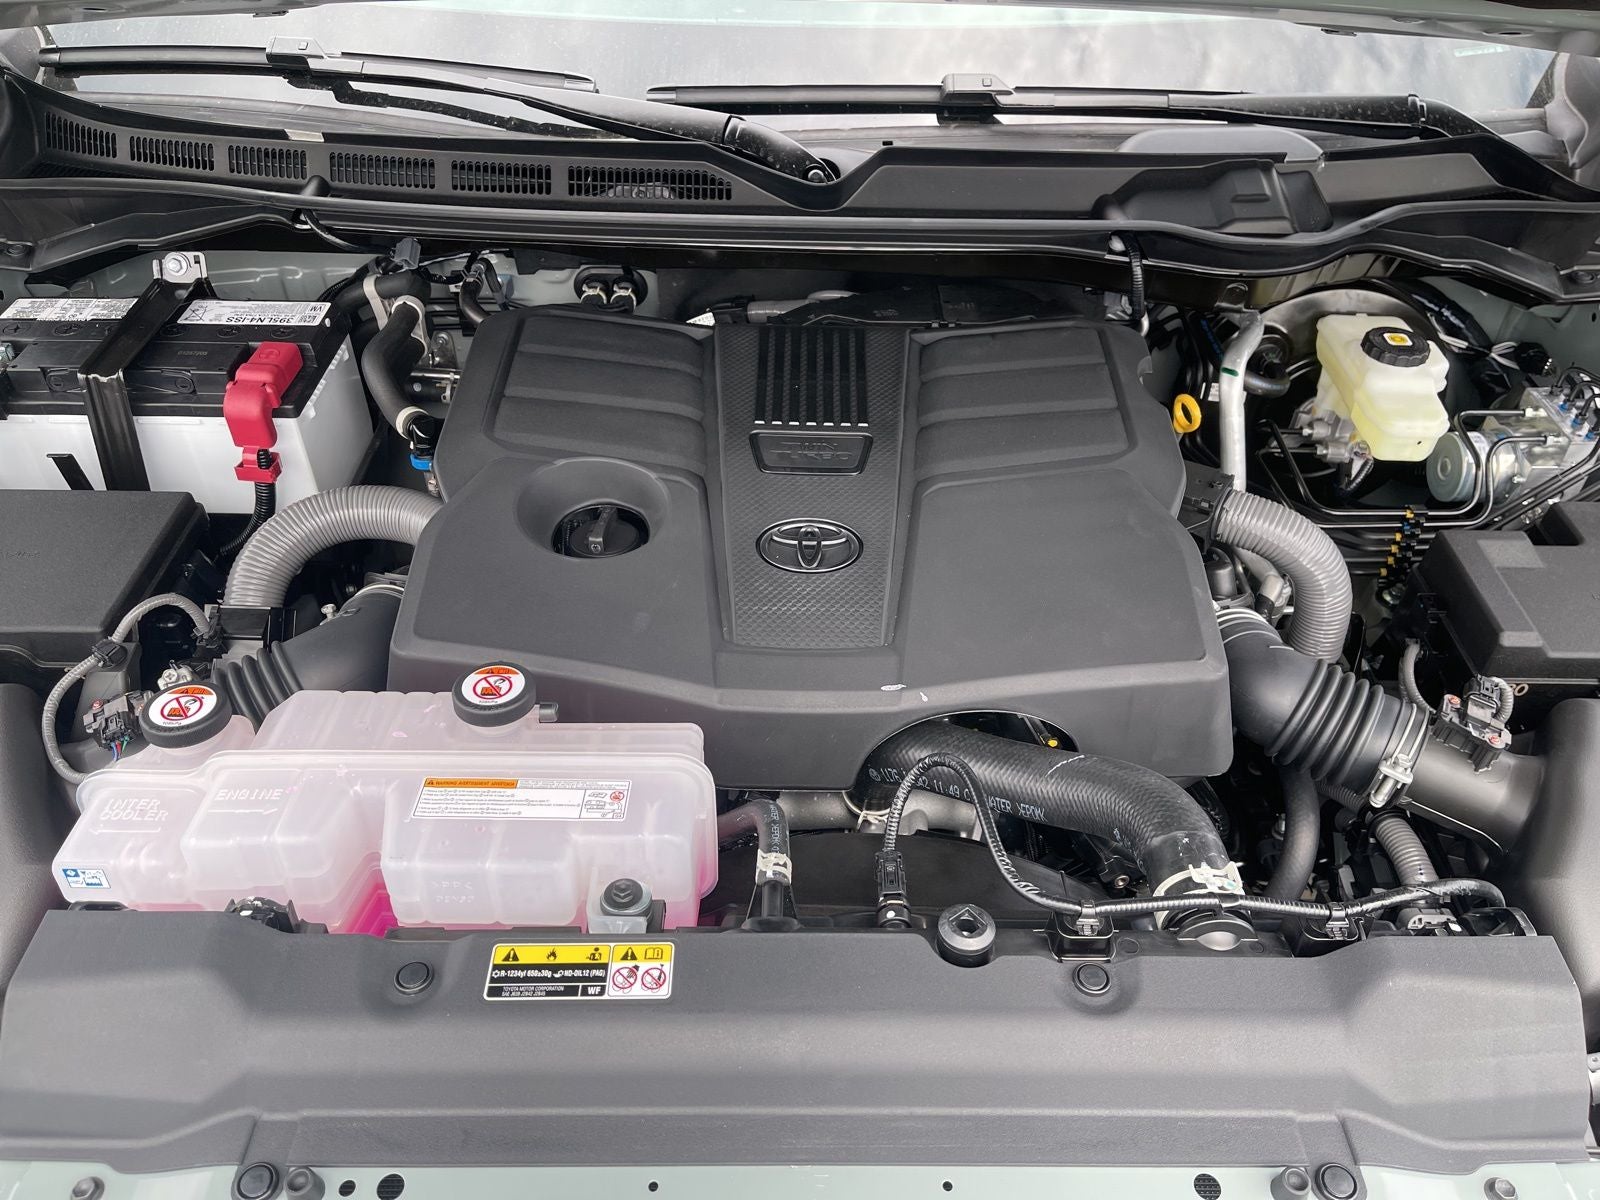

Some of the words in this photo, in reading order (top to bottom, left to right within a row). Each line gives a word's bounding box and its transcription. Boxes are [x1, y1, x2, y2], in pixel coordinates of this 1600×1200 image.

[226, 316, 295, 324] 395LN4-ISS
[769, 450, 853, 460] TURBO
[214, 788, 284, 801] ENGINE
[104, 799, 161, 811] INTER
[100, 809, 169, 822] COOLER
[500, 969, 526, 979] R-1234yf
[587, 986, 602, 995] WF
